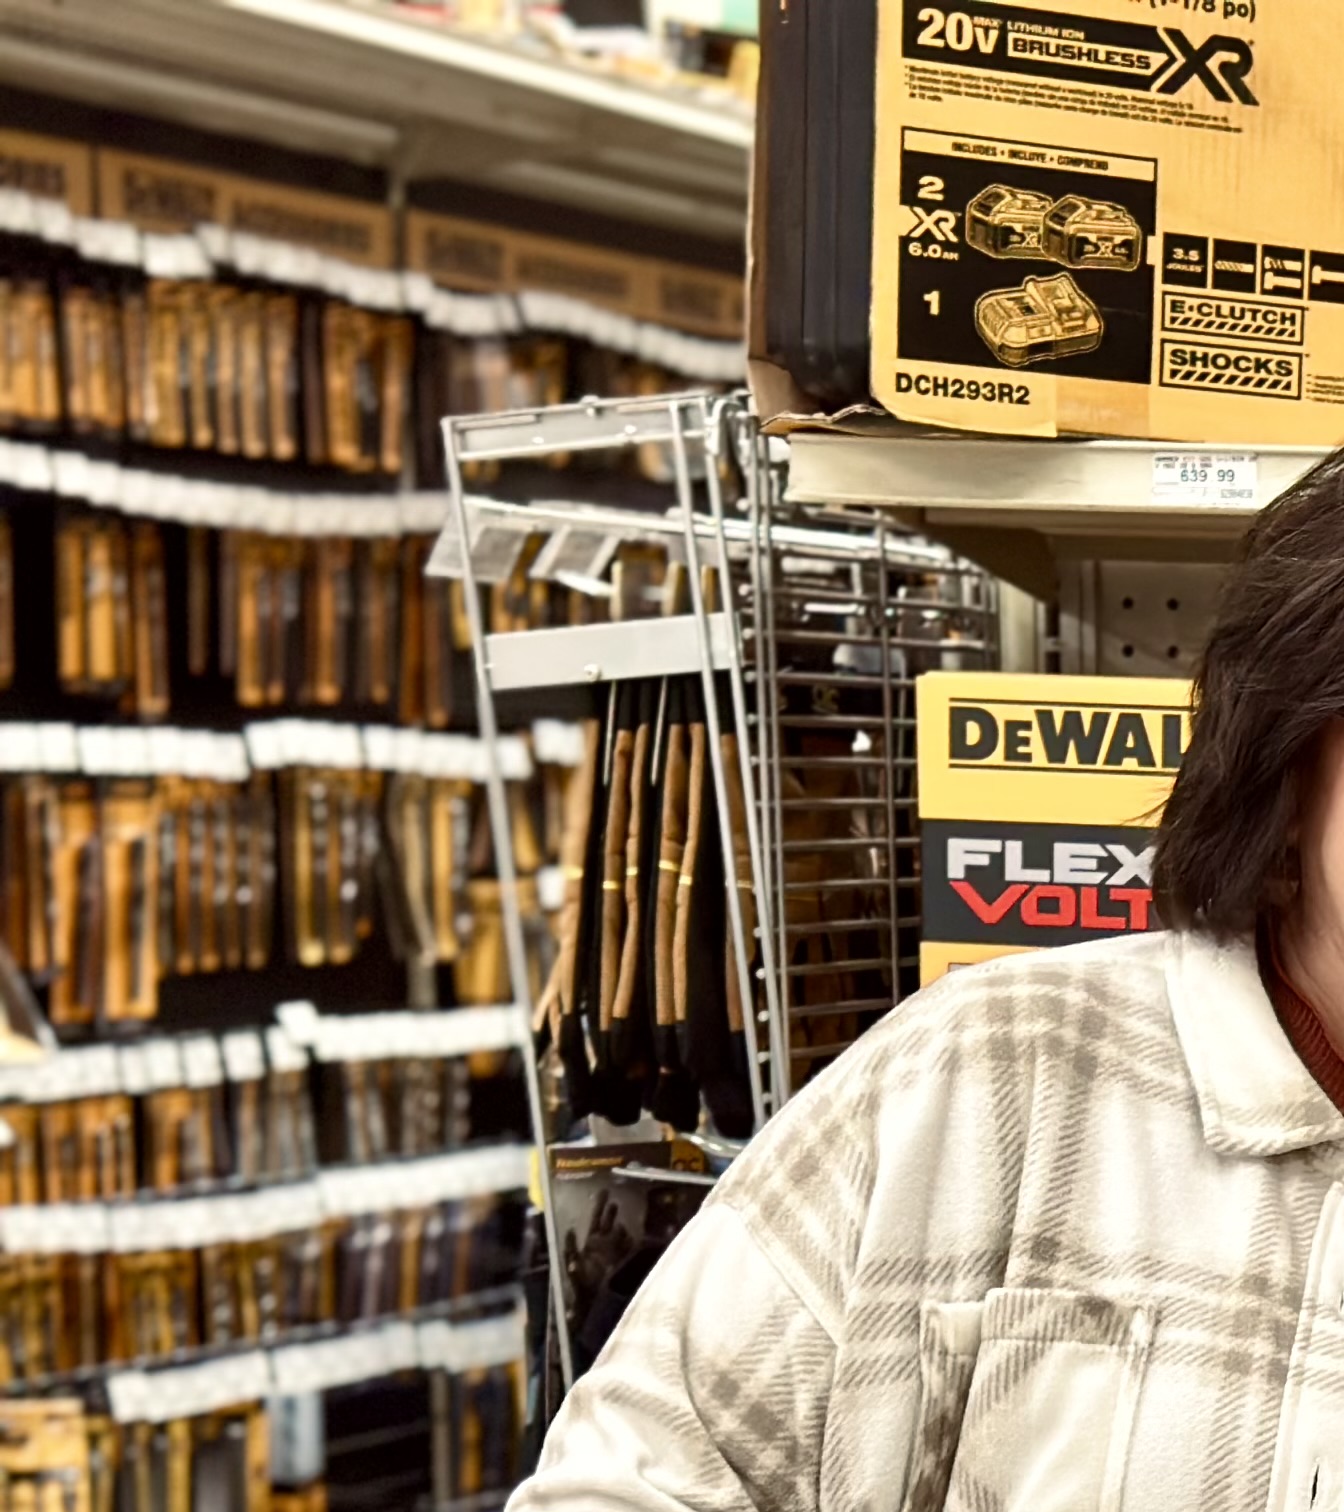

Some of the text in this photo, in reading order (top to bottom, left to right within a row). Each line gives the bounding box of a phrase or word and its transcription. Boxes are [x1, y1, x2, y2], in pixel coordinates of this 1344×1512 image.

[1006, 20, 1085, 42] LITHIUM ION
[1012, 37, 1152, 71] BRUSHLESS
[1155, 28, 1260, 107] XR
[917, 175, 944, 201] 2
[923, 290, 941, 315] 1
[1169, 349, 1293, 378] SHOCKS
[894, 372, 1031, 405] DCH293R2
[949, 706, 1184, 768] DEWAL
[947, 837, 1156, 886] FLEX
[949, 880, 1153, 930] VOLT
